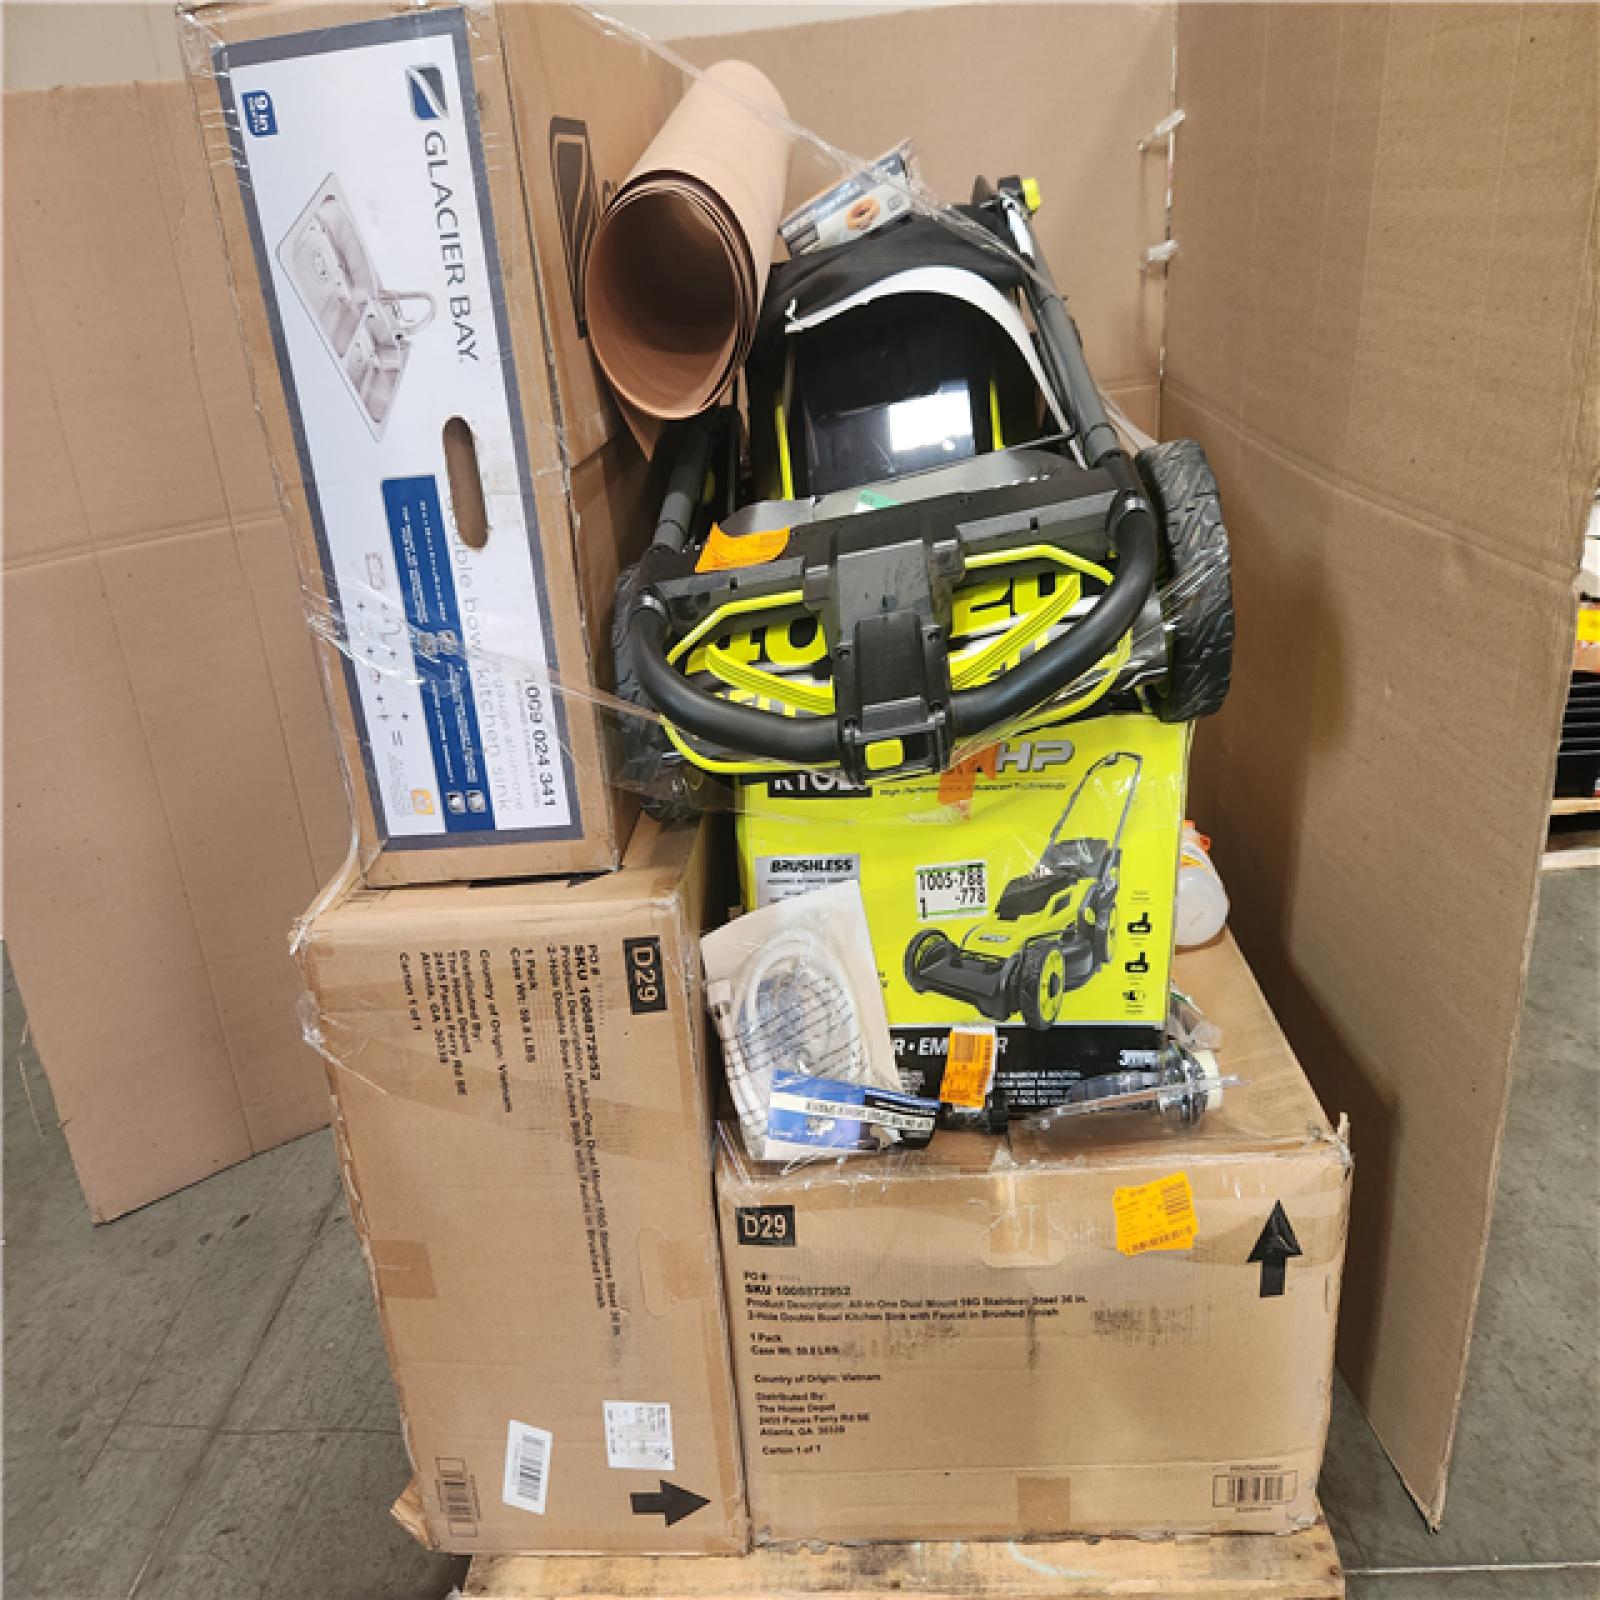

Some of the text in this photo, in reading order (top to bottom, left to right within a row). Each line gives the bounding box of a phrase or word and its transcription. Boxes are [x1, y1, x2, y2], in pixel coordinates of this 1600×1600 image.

[424, 131, 465, 286] GLACIER
[477, 668, 500, 755] kitchen
[491, 765, 512, 810] sink
[532, 729, 553, 766] 024
[995, 739, 1075, 772] HP
[540, 773, 557, 806] 341
[769, 858, 853, 873] BRUSHLESS
[400, 952, 414, 996] Carton
[510, 947, 522, 980] Case
[525, 959, 537, 990] Pack
[560, 945, 574, 996] Product
[575, 945, 589, 980] SKU
[632, 945, 659, 1002] D29
[460, 949, 479, 1020] Distributed
[447, 950, 471, 1053] The Home Depot
[553, 992, 566, 1036] Double
[479, 949, 494, 1000] Country
[488, 1003, 498, 1016] of
[497, 1064, 512, 1113] Vietnam
[560, 1039, 571, 1068] Bowl
[565, 1072, 577, 1118] Kitchen
[742, 1212, 787, 1239] D29
[744, 1284, 771, 1296] SKU
[746, 1298, 785, 1309] Product
[780, 1311, 815, 1322] Double
[817, 1312, 843, 1321] Bowl
[845, 1312, 883, 1321] Kitchen
[884, 1312, 907, 1321] Sink
[750, 1345, 776, 1356] Case
[757, 1332, 783, 1343] Pack
[754, 1373, 792, 1386] Country
[794, 1374, 806, 1384] of
[841, 1373, 881, 1382] Vietnam
[754, 1392, 808, 1402] Distributed
[757, 1403, 836, 1413] The Home Depot
[762, 1446, 794, 1456] Carton
